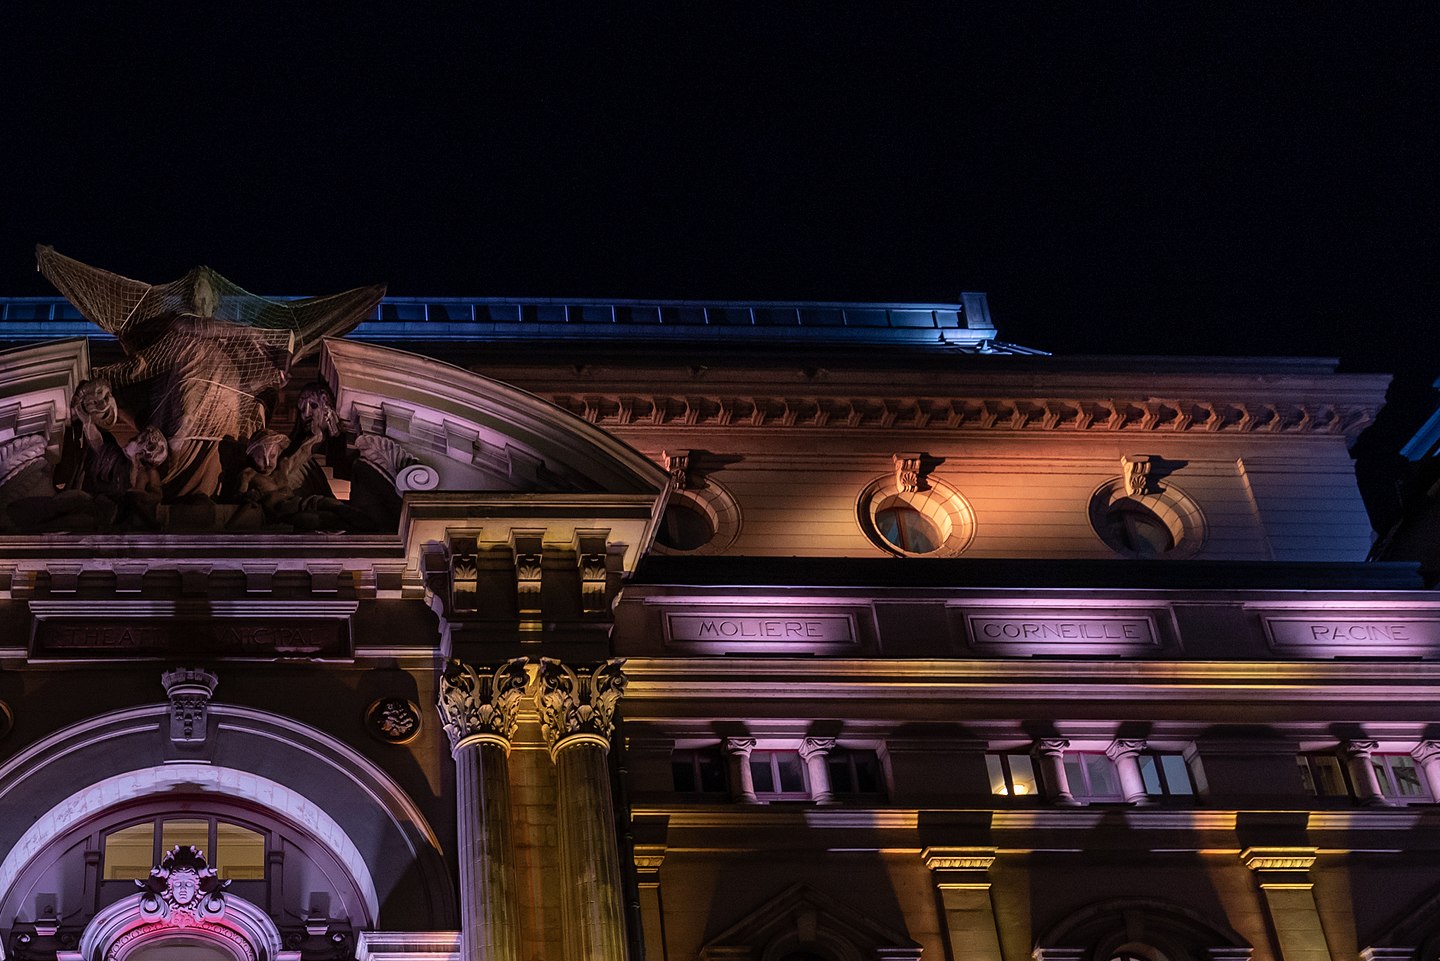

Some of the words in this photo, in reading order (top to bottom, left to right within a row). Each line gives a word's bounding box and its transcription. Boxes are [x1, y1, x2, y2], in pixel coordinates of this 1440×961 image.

[65, 626, 174, 646] THEATR
[205, 626, 321, 646] VNICIPAL
[698, 620, 824, 638] MOLIERE
[983, 622, 1141, 639] CORNEILLE
[1310, 624, 1410, 641] RACINE
